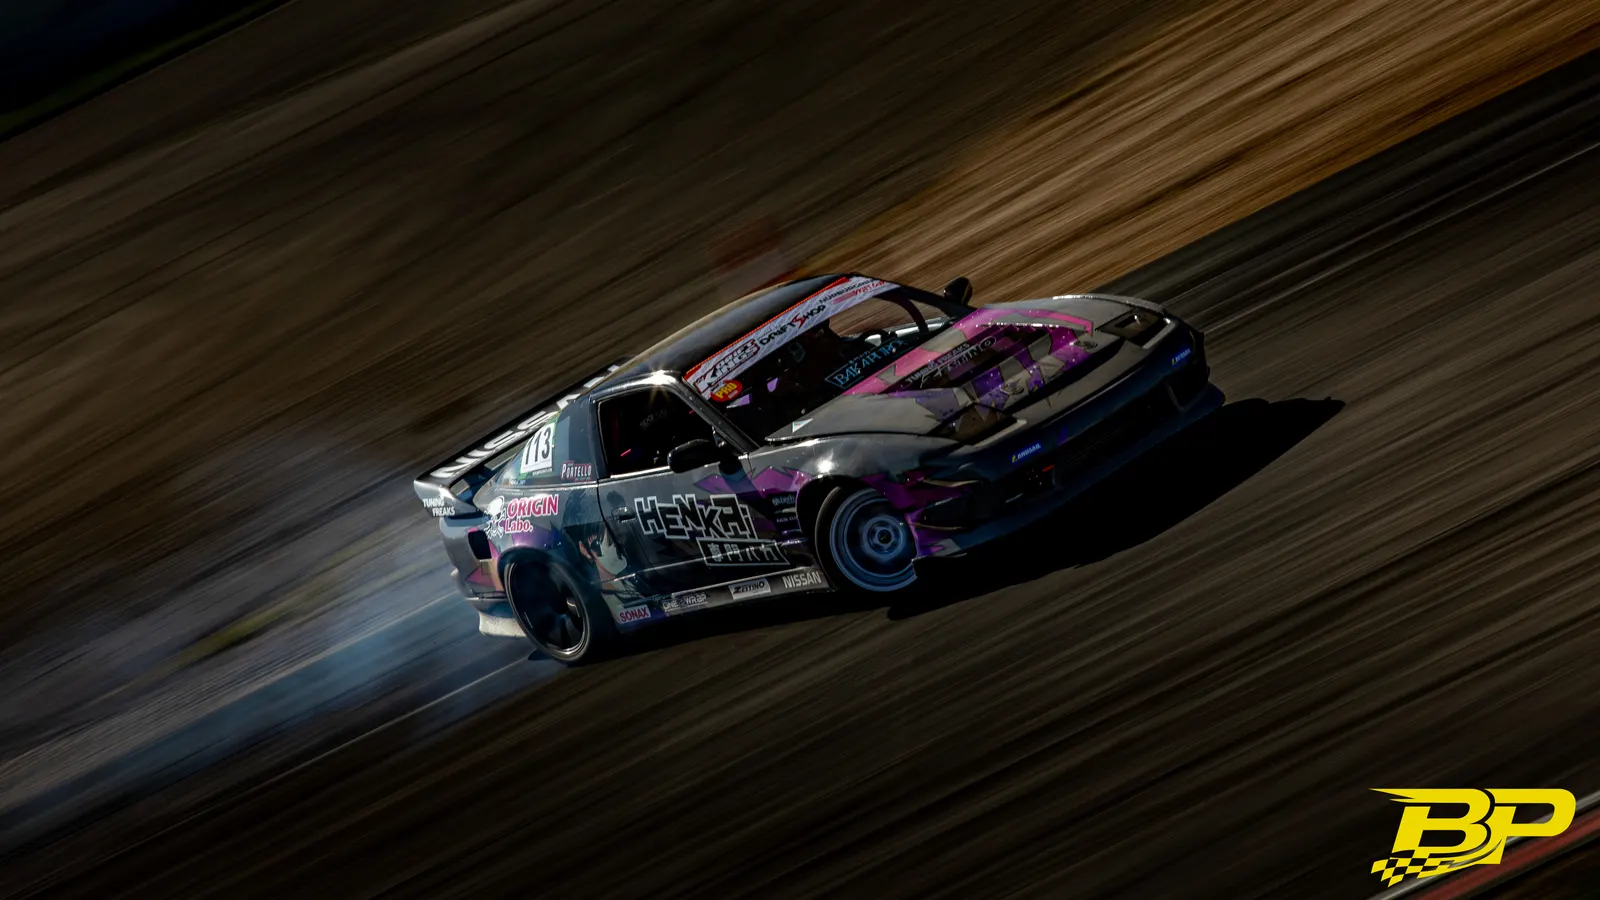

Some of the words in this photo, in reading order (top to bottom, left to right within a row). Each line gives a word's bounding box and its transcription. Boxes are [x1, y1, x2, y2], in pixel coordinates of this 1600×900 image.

[715, 381, 737, 399] PRO
[525, 427, 551, 465] 113
[561, 463, 592, 479] PORTELLO
[423, 498, 445, 508] TUNING
[432, 507, 456, 516] FREAKS
[506, 494, 559, 518] ORIGIN
[782, 571, 822, 589] NISSAN
[619, 607, 649, 623] SONAX
